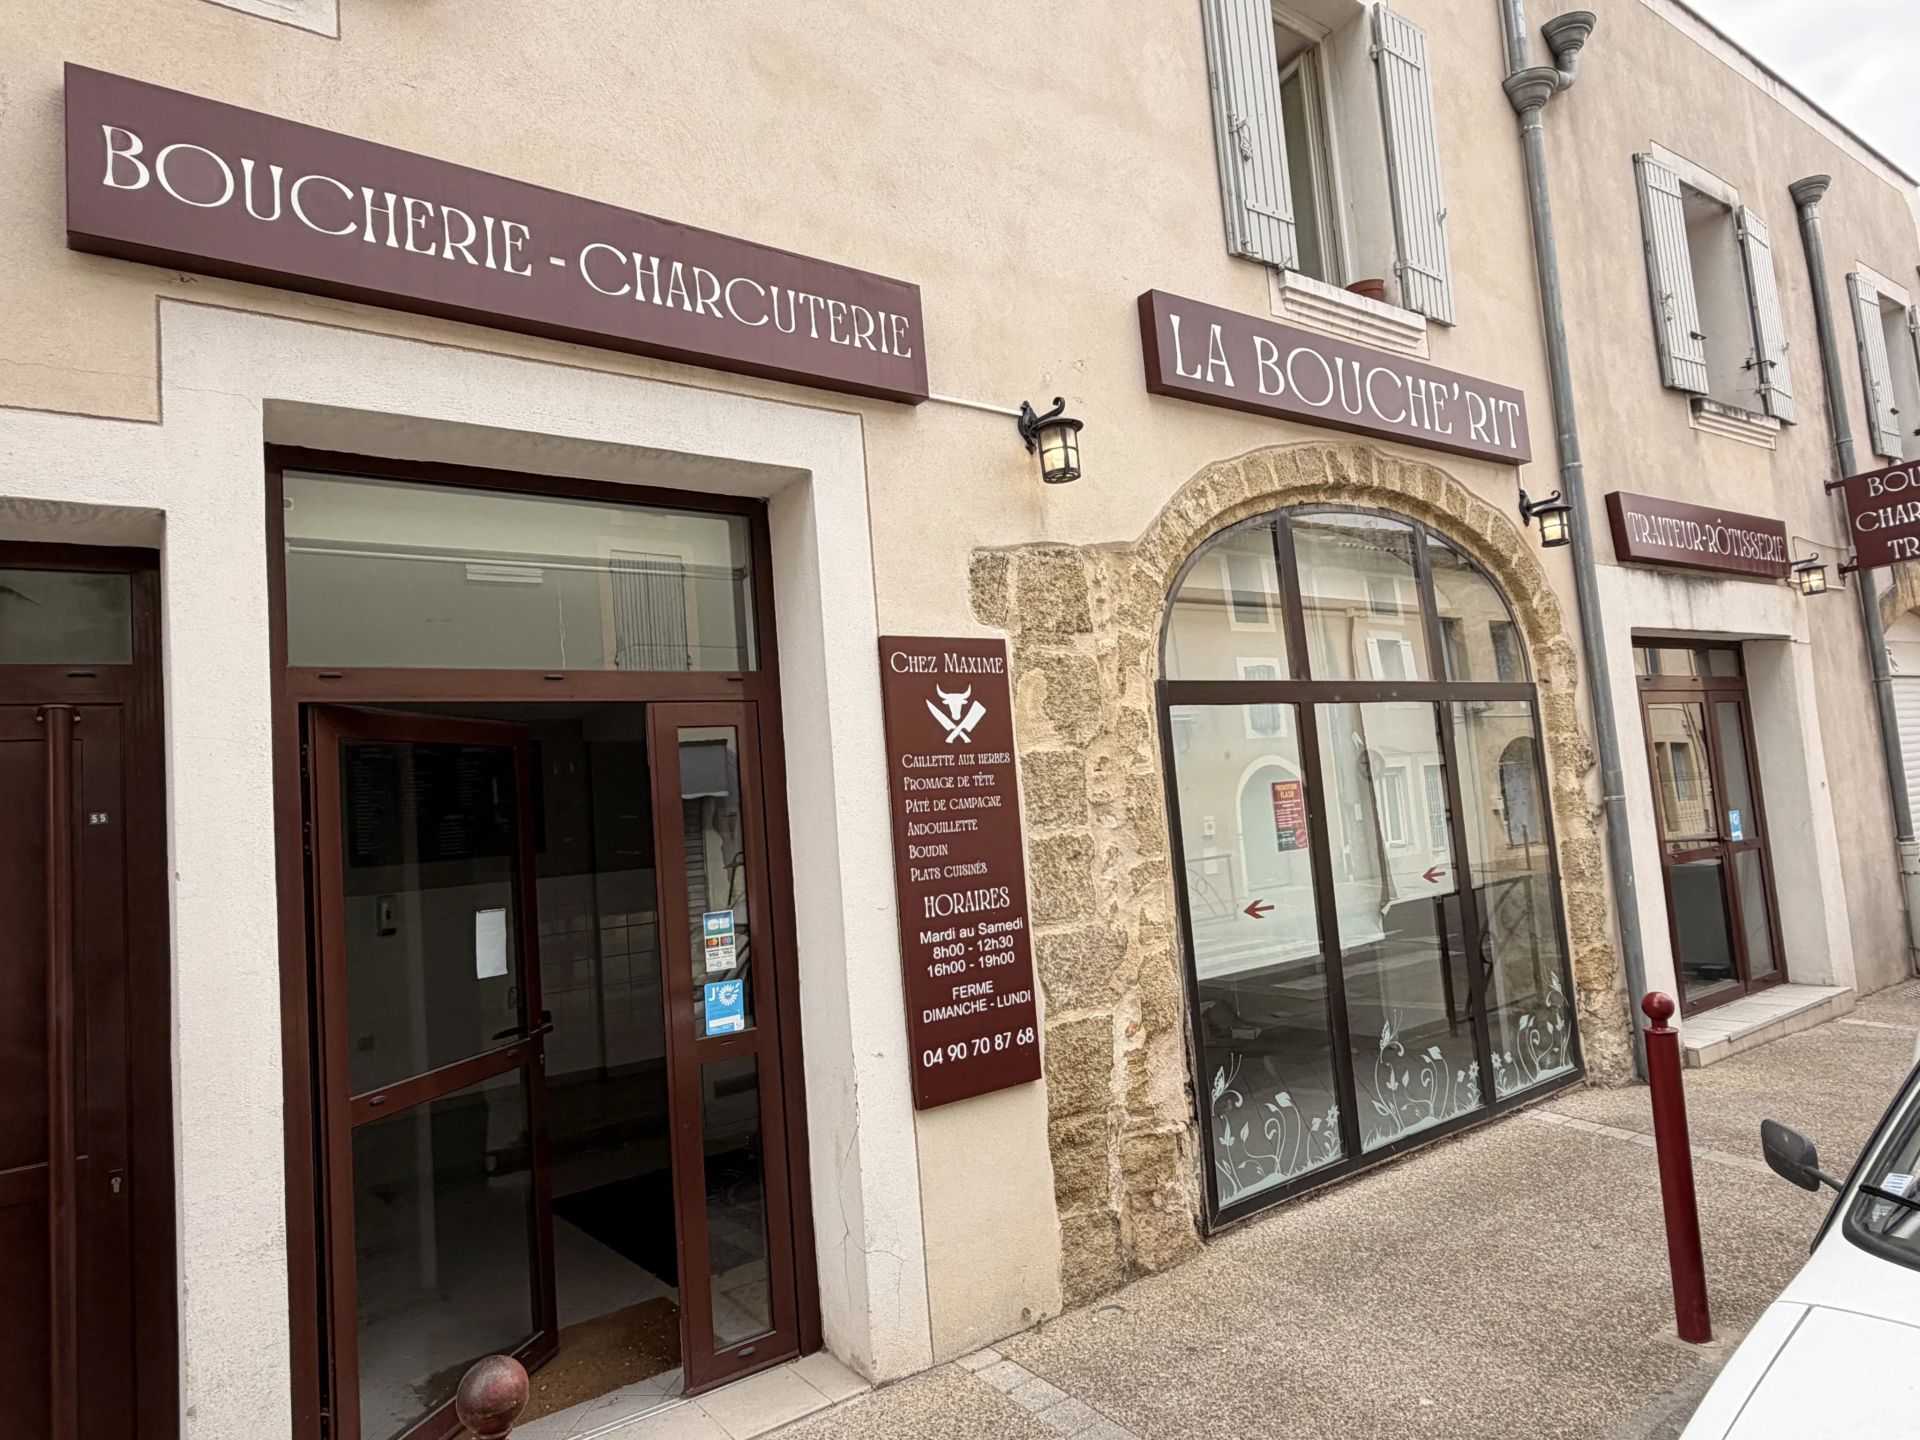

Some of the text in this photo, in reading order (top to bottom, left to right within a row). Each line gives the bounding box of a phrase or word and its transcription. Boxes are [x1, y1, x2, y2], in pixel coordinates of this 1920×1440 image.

[101, 124, 532, 276] BOUCHERIE
[579, 242, 912, 358] CHARCUTERIE
[1169, 313, 1520, 449] LA BOUCHE'RIT
[1627, 511, 1786, 563] TRAITEUR-RÔTISSERIE
[890, 651, 1004, 674] CHEZ MAXIME
[902, 752, 1011, 768] CAILLETTE AUX HERBES
[903, 775, 954, 791] FROMAGE
[957, 775, 970, 788] DE
[933, 799, 946, 811] DE
[949, 796, 1002, 810] CAMPAGNE
[907, 819, 978, 837] ANDOUILLETTE
[908, 843, 948, 859] BOUDIN
[910, 866, 941, 882] PLATS
[924, 886, 1010, 919] HORAIRES
[919, 916, 1024, 945] Mardi au Samedi
[933, 943, 965, 960] 8h00
[977, 934, 1014, 952] 12h30
[927, 959, 966, 978] 16h00
[978, 951, 1015, 968] 19h00
[952, 980, 994, 1000] FERME
[923, 998, 988, 1024] DIMANCHE
[997, 989, 1031, 1008] LUNDI
[923, 1026, 1035, 1068] 04 90 70 87 68
